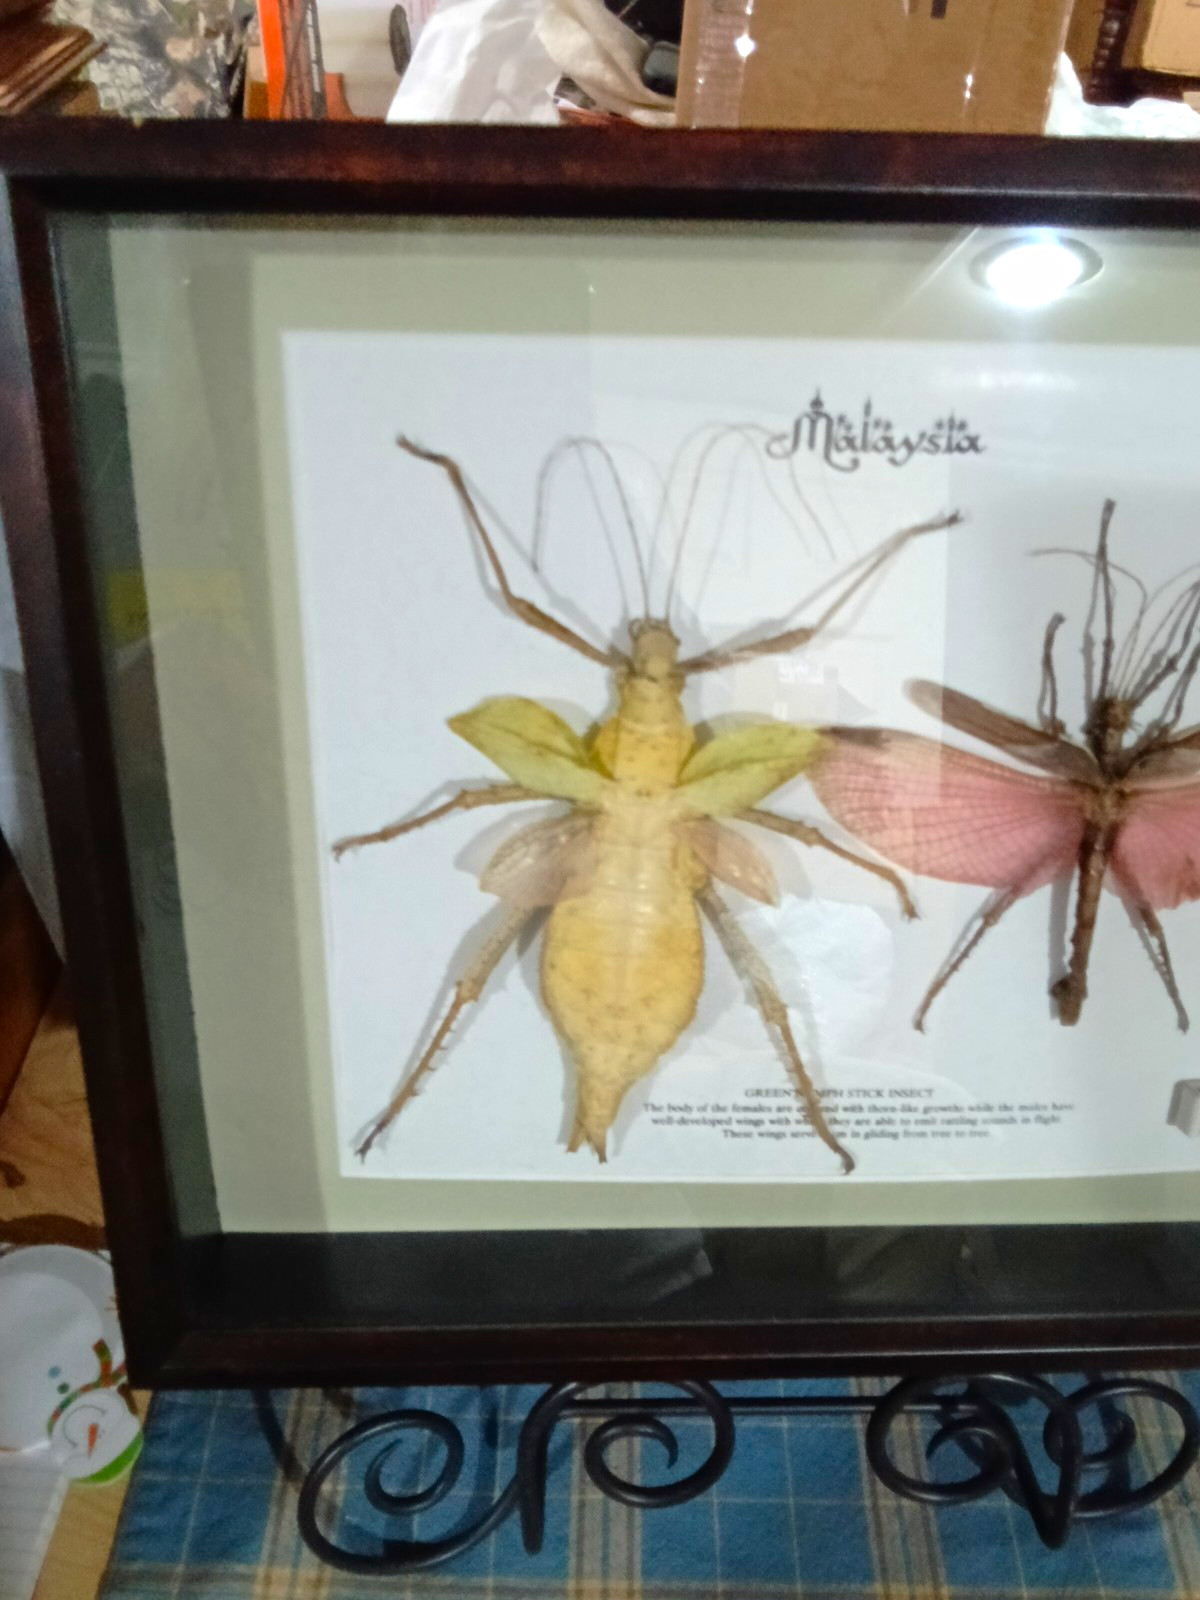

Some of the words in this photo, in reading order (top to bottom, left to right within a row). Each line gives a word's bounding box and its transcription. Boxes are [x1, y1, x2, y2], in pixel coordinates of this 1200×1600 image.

[767, 388, 984, 472] Malaysia
[847, 1088, 884, 1098] STICK
[888, 1088, 934, 1098] INSECT
[643, 1103, 663, 1112] The
[667, 1103, 692, 1115] body
[697, 1103, 708, 1112] of
[711, 1103, 727, 1112] the
[842, 1104, 864, 1113] with
[998, 1103, 1014, 1112] the
[735, 1116, 765, 1127] wings
[768, 1117, 791, 1125] with
[875, 1117, 896, 1125] able
[722, 1129, 753, 1138] These
[757, 1129, 786, 1140] wings
[850, 1130, 860, 1138] in
[863, 1129, 899, 1140] gliding
[902, 1129, 928, 1138] from
